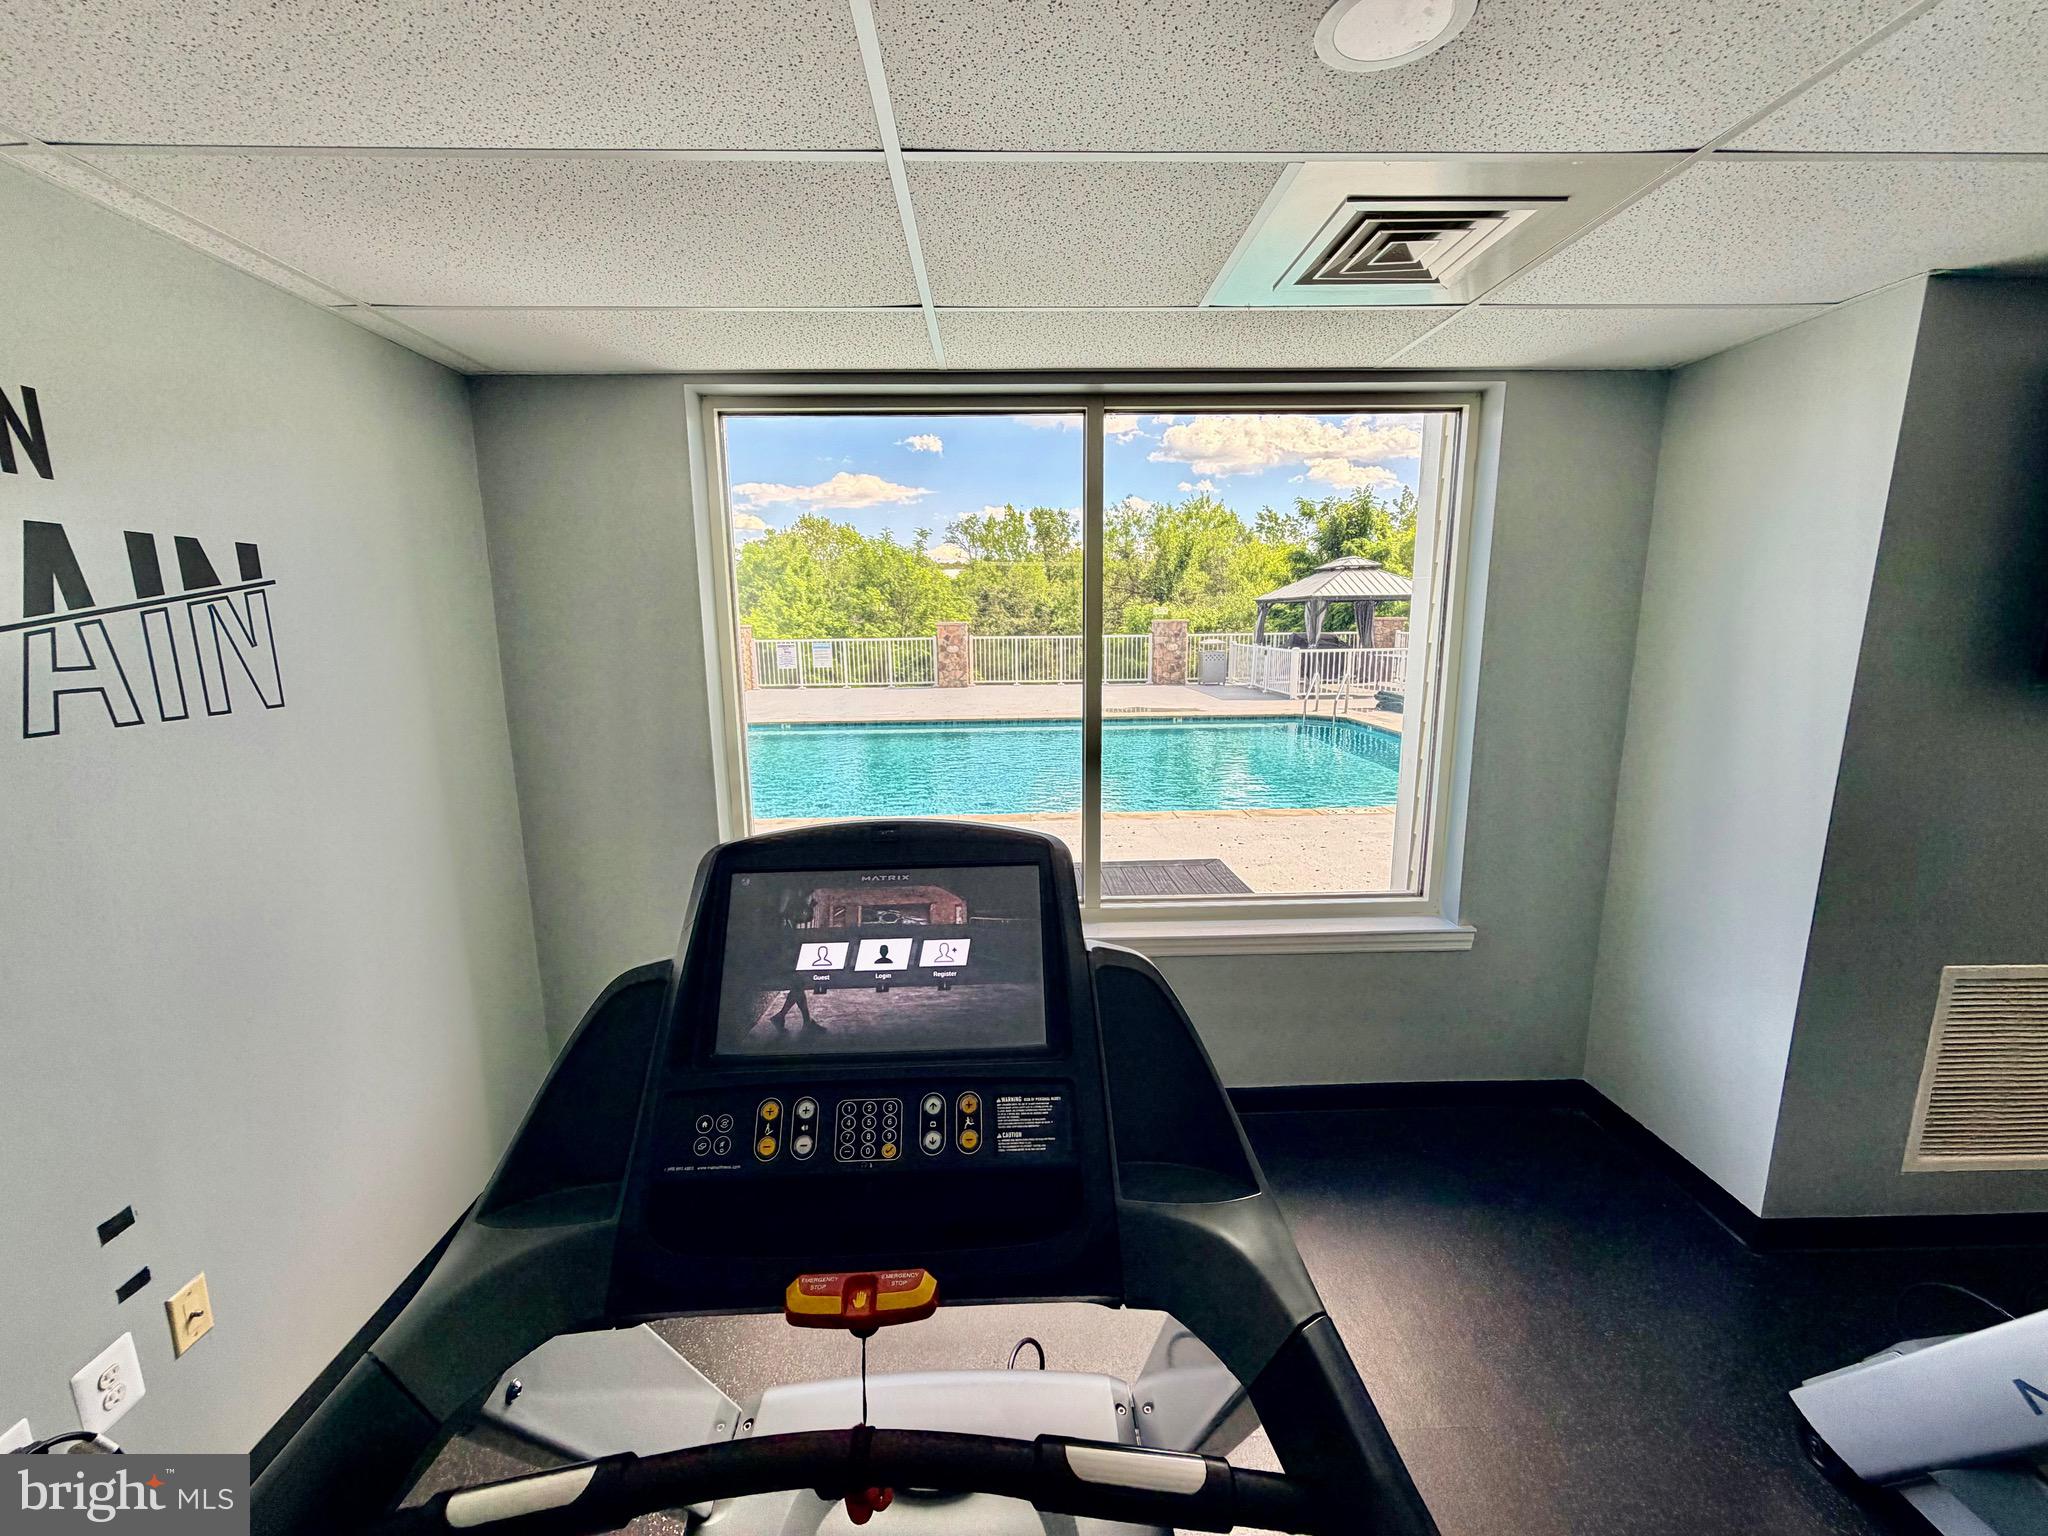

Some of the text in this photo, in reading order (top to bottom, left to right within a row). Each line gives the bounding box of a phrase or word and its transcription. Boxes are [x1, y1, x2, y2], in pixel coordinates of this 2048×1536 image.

[23, 520, 285, 739] AIN
[875, 972, 892, 980] Login
[932, 970, 958, 978] Register
[801, 1276, 839, 1284] EMERGENCY
[881, 1272, 920, 1280] EMERGENCY
